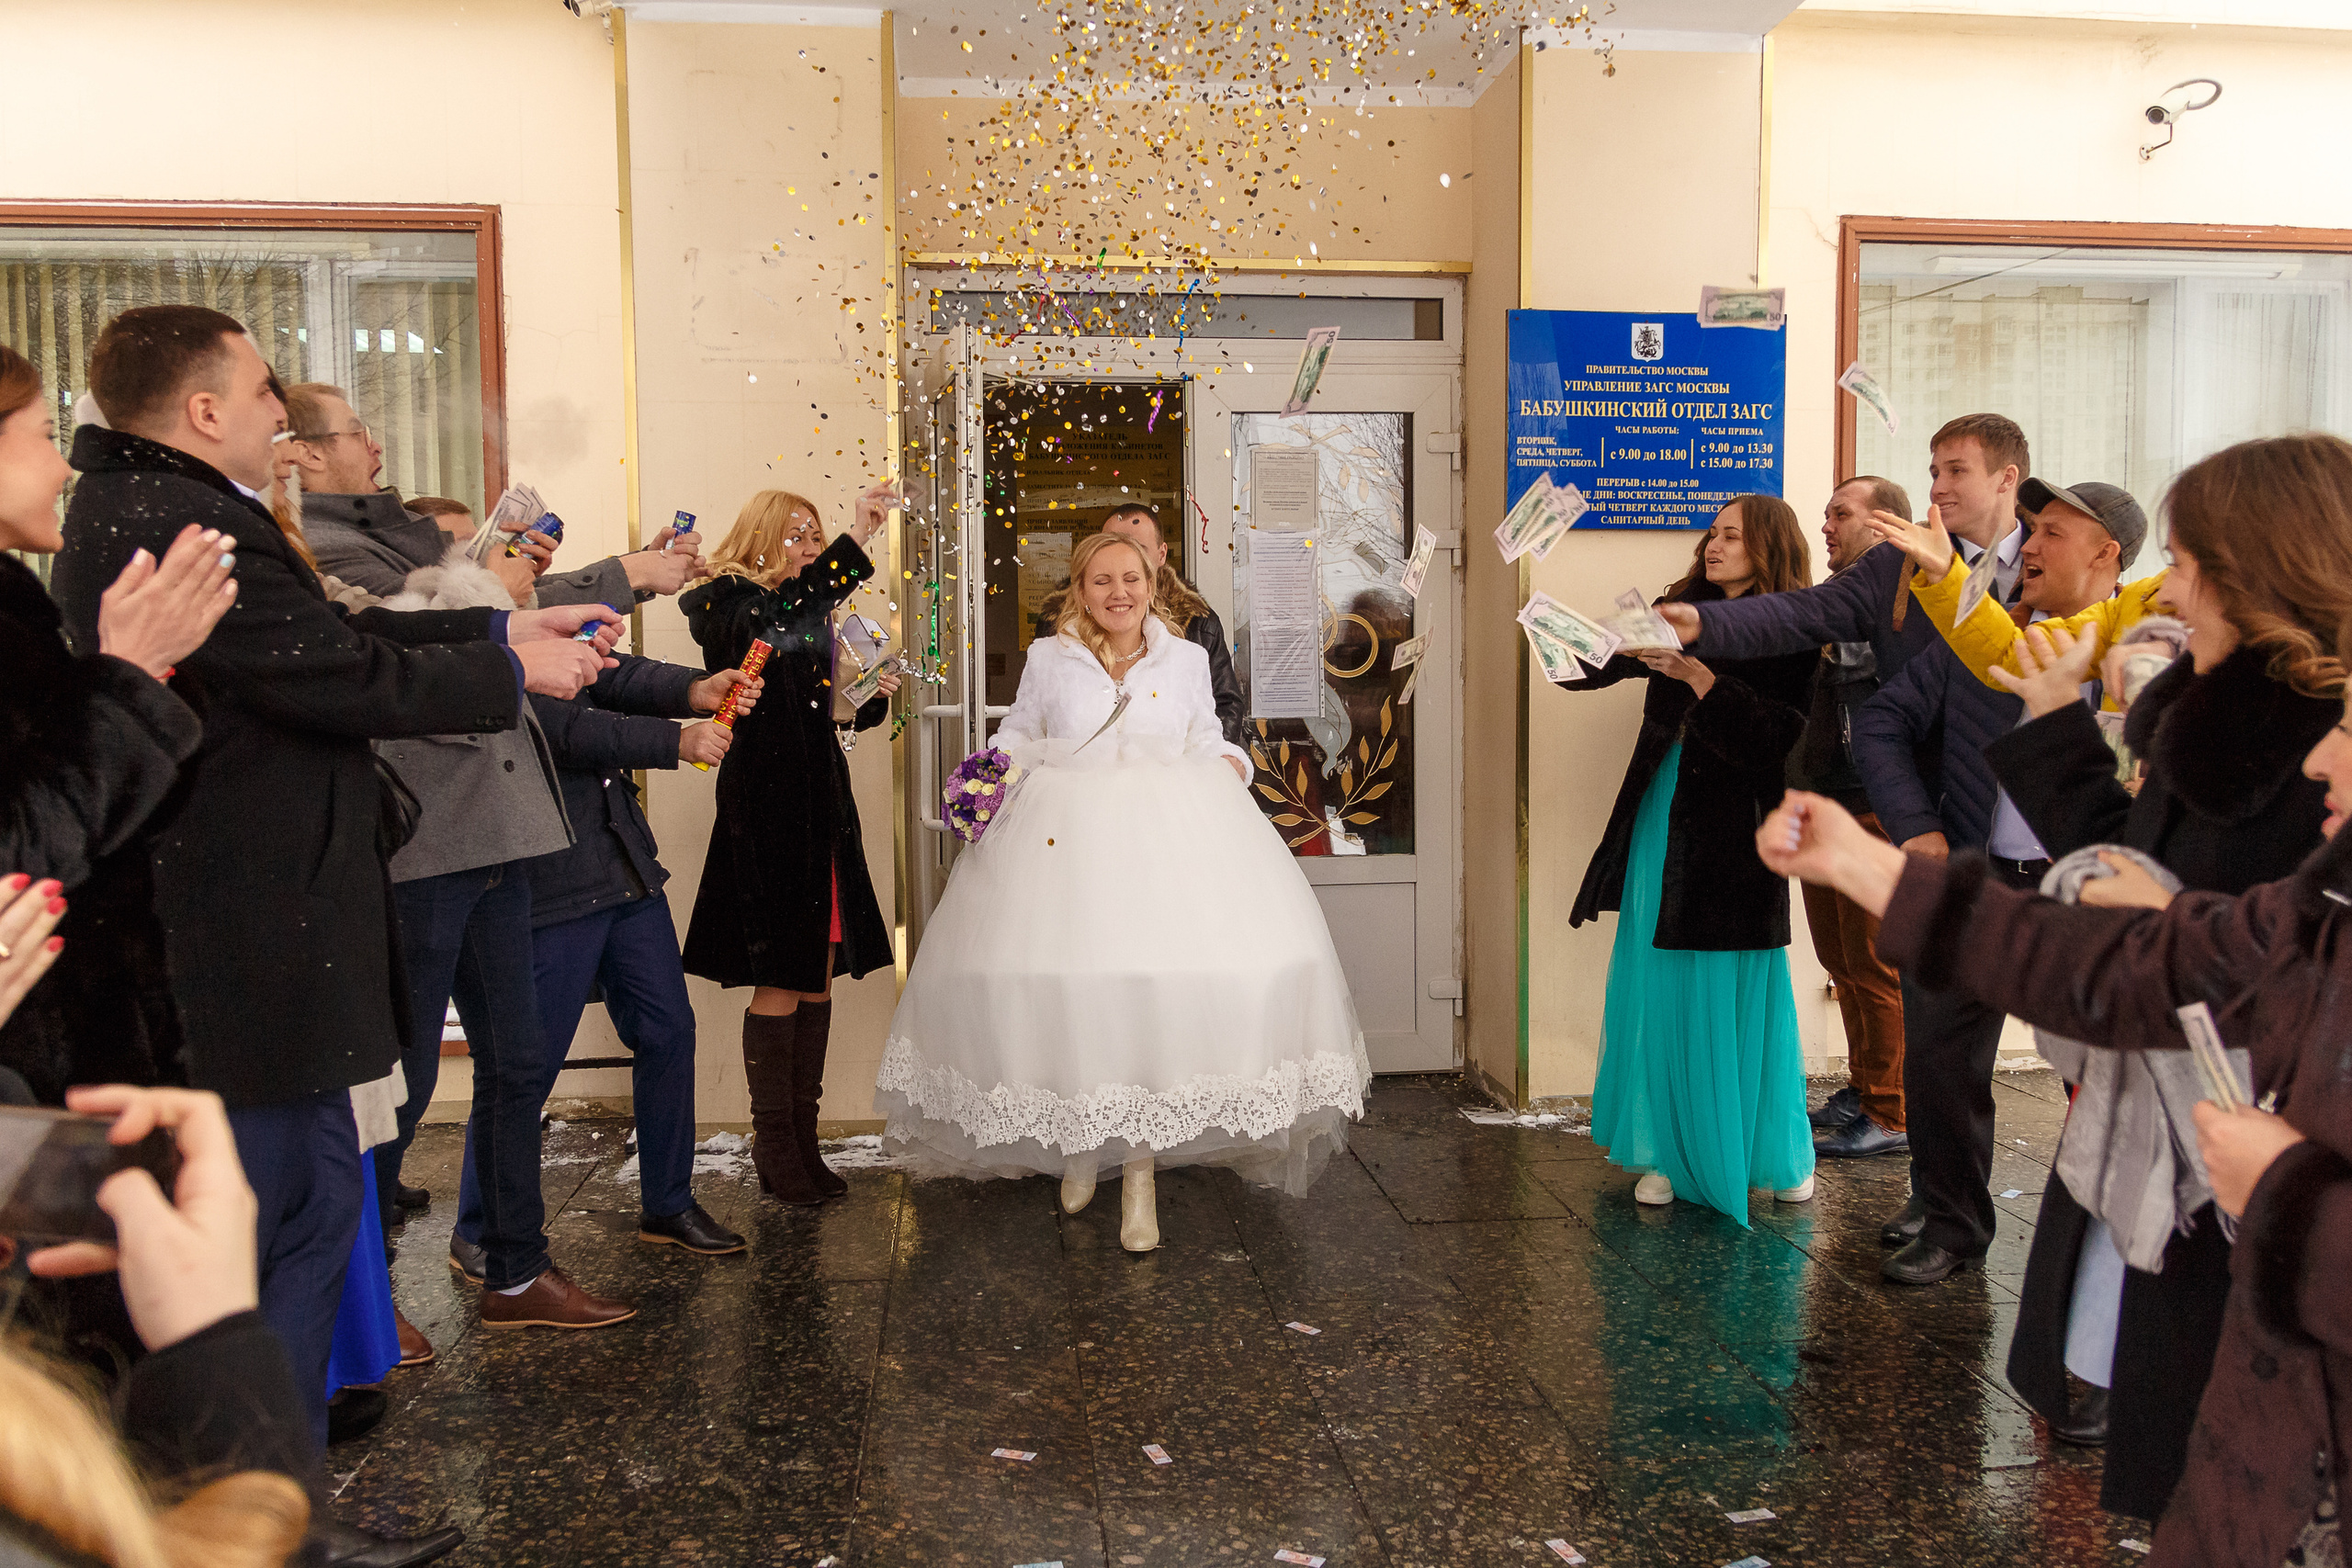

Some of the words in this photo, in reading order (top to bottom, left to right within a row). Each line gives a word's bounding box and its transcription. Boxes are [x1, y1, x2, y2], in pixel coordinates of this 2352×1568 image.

[1326, 331, 1336, 344] 50
[1586, 365, 1665, 376] ПРАВИТЕЛЬСТВО
[1666, 367, 1709, 376] МОСКВЫ
[1564, 379, 1642, 393] УПРАВЛЕНИЕ
[1645, 381, 1674, 393] ЗАГС
[1676, 382, 1730, 394] МОСКВЫ
[1520, 398, 1668, 418] БАБУШКИНСКИЙ
[1671, 402, 1727, 421] ОТДЕЛ
[1731, 402, 1773, 421] ЗАГС
[1614, 425, 1640, 434] ЧАСЫ
[1642, 425, 1679, 434] РАБОТЫ:
[1701, 426, 1726, 435] ЧАСЫ
[1727, 427, 1764, 436] ПРИЕМА
[1516, 435, 1557, 446] ВТОРНИК,
[1516, 446, 1545, 457] СРЕДА,
[1545, 447, 1583, 457] ЧЕТВЕРГ,
[1610, 450, 1617, 460] с
[1618, 447, 1642, 460] 9.00
[1643, 451, 1657, 461] до
[1659, 448, 1687, 461] 18.00
[1701, 445, 1706, 453] с
[1709, 442, 1730, 454] 9.00
[1731, 445, 1745, 454] до
[1747, 443, 1774, 455] 13.30
[1110, 452, 1145, 461] ОТДЕЛА
[1147, 452, 1170, 460] ЗАГС
[1516, 457, 1559, 468] ПЯТНИЦА,
[1559, 458, 1597, 468] СУББОТА
[1700, 459, 1706, 468] с
[1709, 457, 1734, 468] 15.00
[1734, 460, 1747, 469] до
[1749, 457, 1774, 469] 17.30
[1596, 478, 1640, 487] ПЕРЕРЫВ
[1647, 479, 1668, 488] 14.00
[1679, 479, 1700, 488] 15.00
[1592, 490, 1616, 500] ДНИ:
[1617, 491, 1686, 501] ВОСКРЕСЕНЬЕ,
[1687, 491, 1756, 502] ПОНЕДЕЛЬ
[1608, 502, 1649, 513] ЧЕТВЕРГ
[1649, 503, 1696, 513] КАЖДОГО
[1600, 514, 1665, 525] САНИТАРНЫЙ
[1665, 515, 1691, 525] ДЕНЬ
[1589, 652, 1603, 664] 50
[1547, 669, 1558, 680] 50
[845, 687, 854, 695] 50
